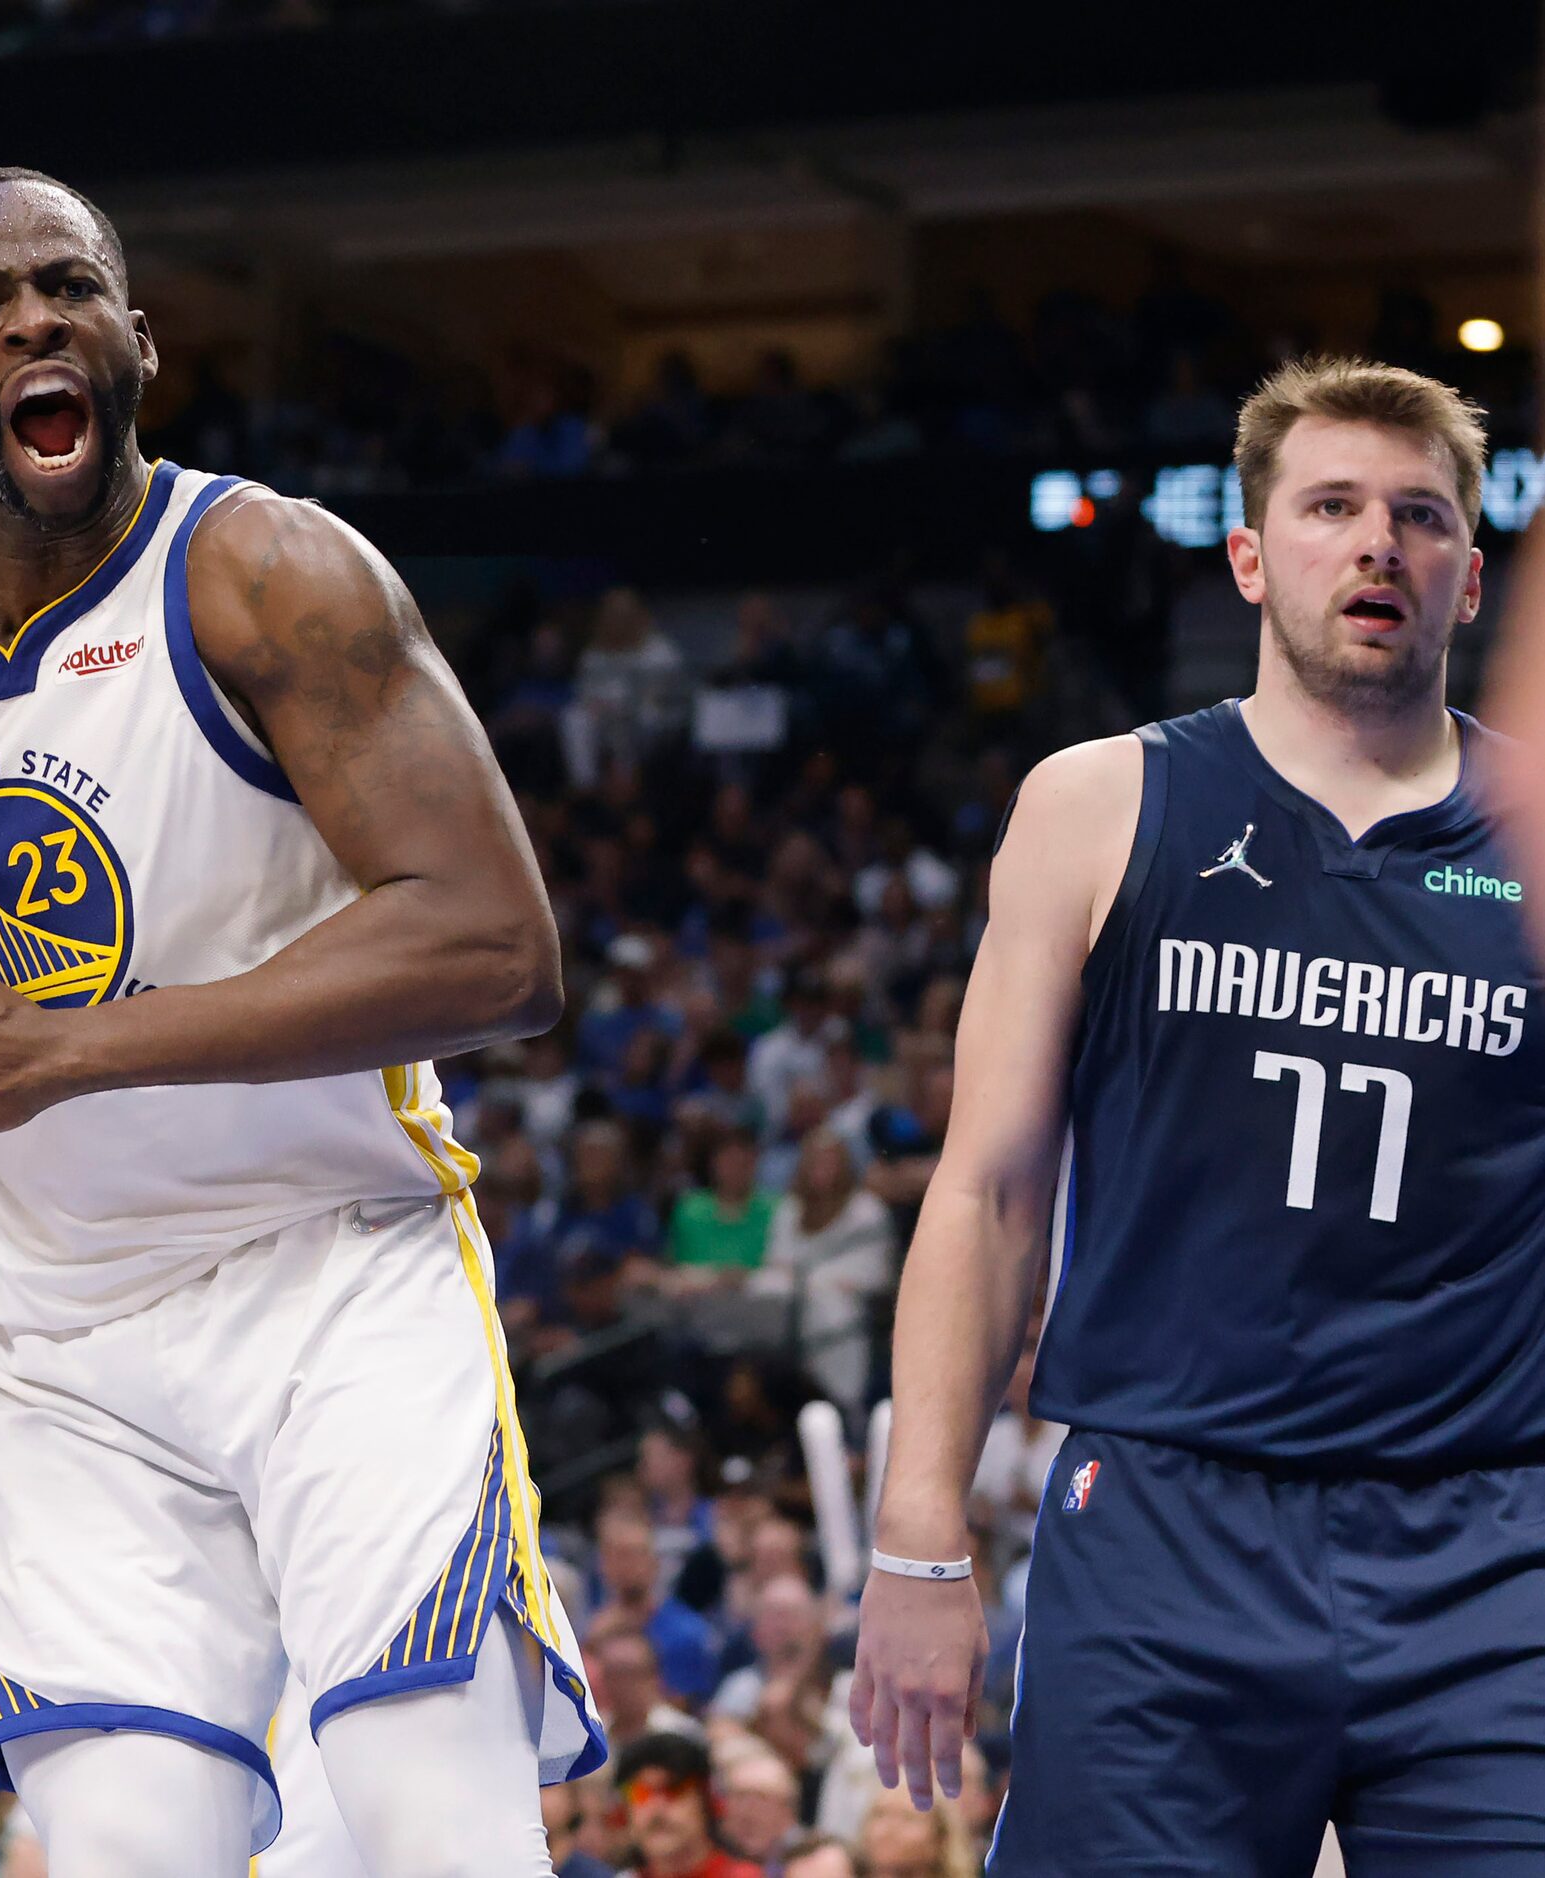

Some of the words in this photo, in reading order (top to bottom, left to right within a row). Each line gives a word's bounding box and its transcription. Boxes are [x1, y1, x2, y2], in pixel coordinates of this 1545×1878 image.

[21, 749, 111, 814] STATE
[7, 827, 88, 917] 23
[1424, 865, 1522, 902] chime
[1158, 938, 1527, 1057] MAVERICKS
[1253, 1050, 1413, 1223] 77
